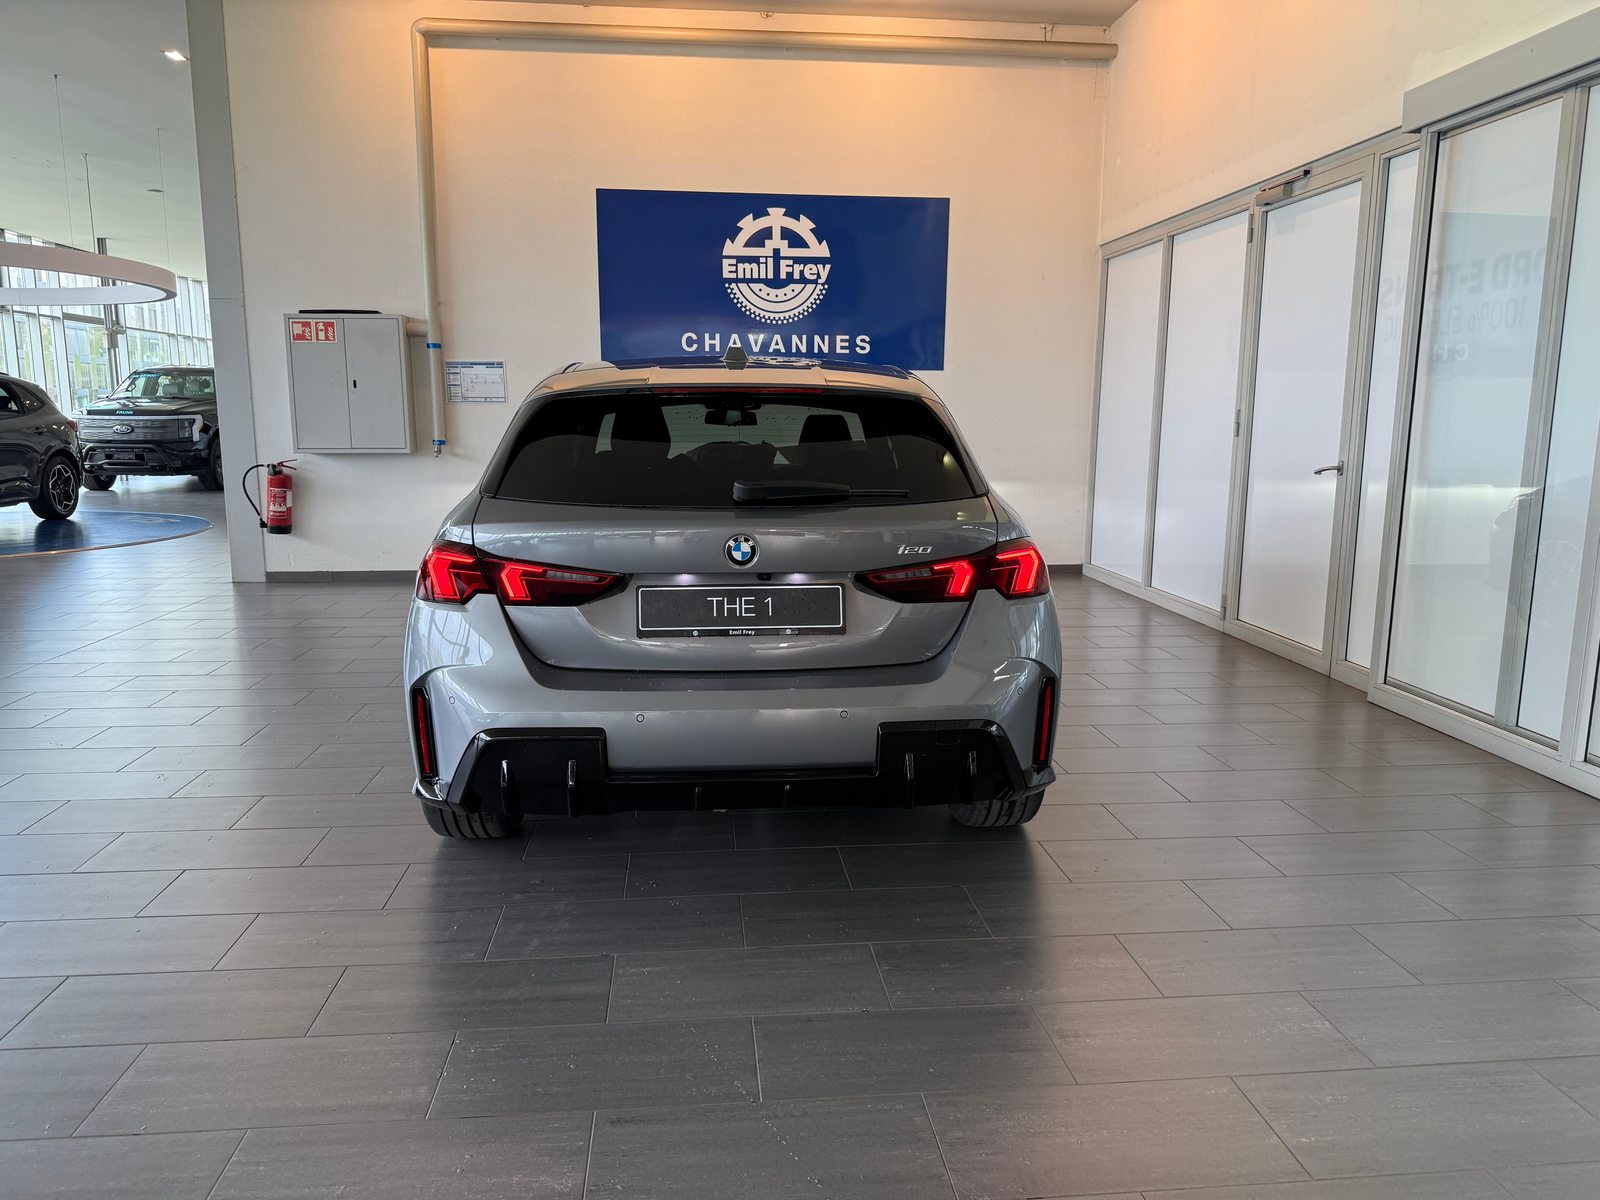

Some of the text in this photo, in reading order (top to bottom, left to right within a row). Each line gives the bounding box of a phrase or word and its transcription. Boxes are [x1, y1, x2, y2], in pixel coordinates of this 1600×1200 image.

[722, 257, 831, 284] Emil Frey
[681, 332, 871, 355] CHAVANNES
[706, 597, 772, 617] THE 1
